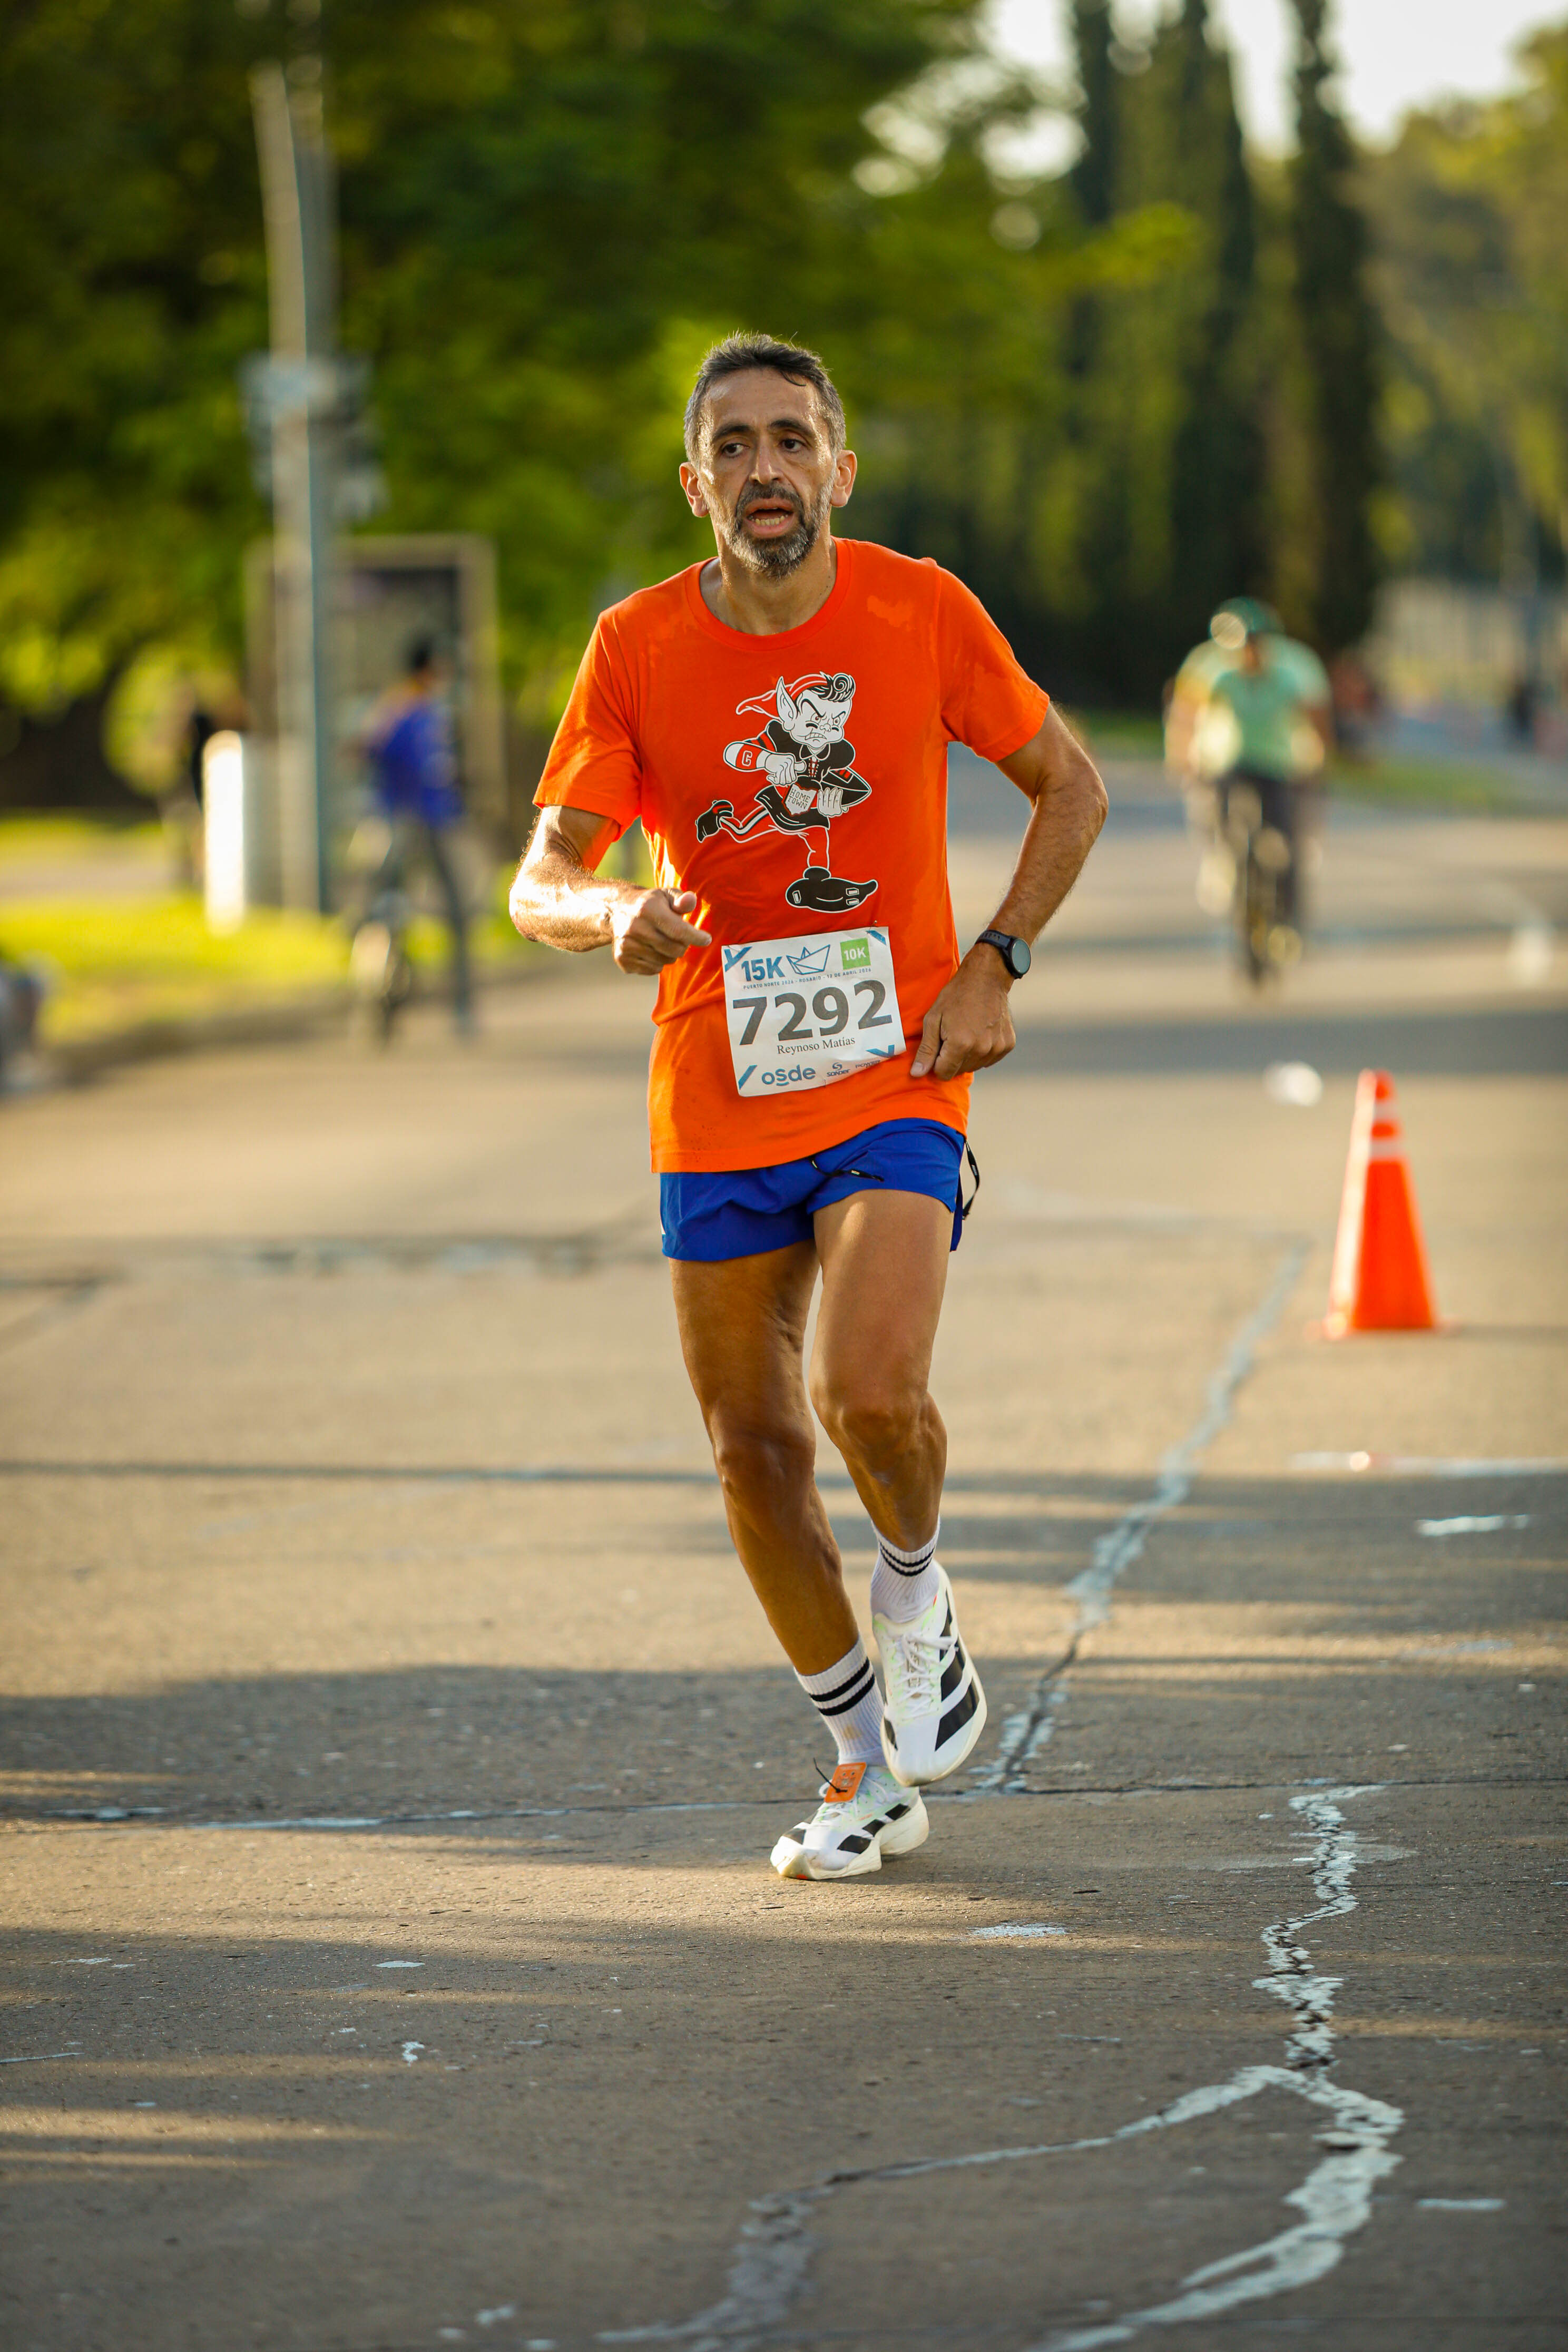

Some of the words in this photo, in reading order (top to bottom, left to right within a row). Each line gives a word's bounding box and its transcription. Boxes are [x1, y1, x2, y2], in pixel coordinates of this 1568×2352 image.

[742, 750, 752, 767] C
[788, 795, 808, 809] TOWN
[790, 788, 810, 803] HOME
[844, 947, 866, 961] 10K
[741, 956, 785, 982] 15K
[733, 979, 893, 1046] 7292
[777, 1043, 820, 1055] Reynoso
[761, 1064, 816, 1086] osde
